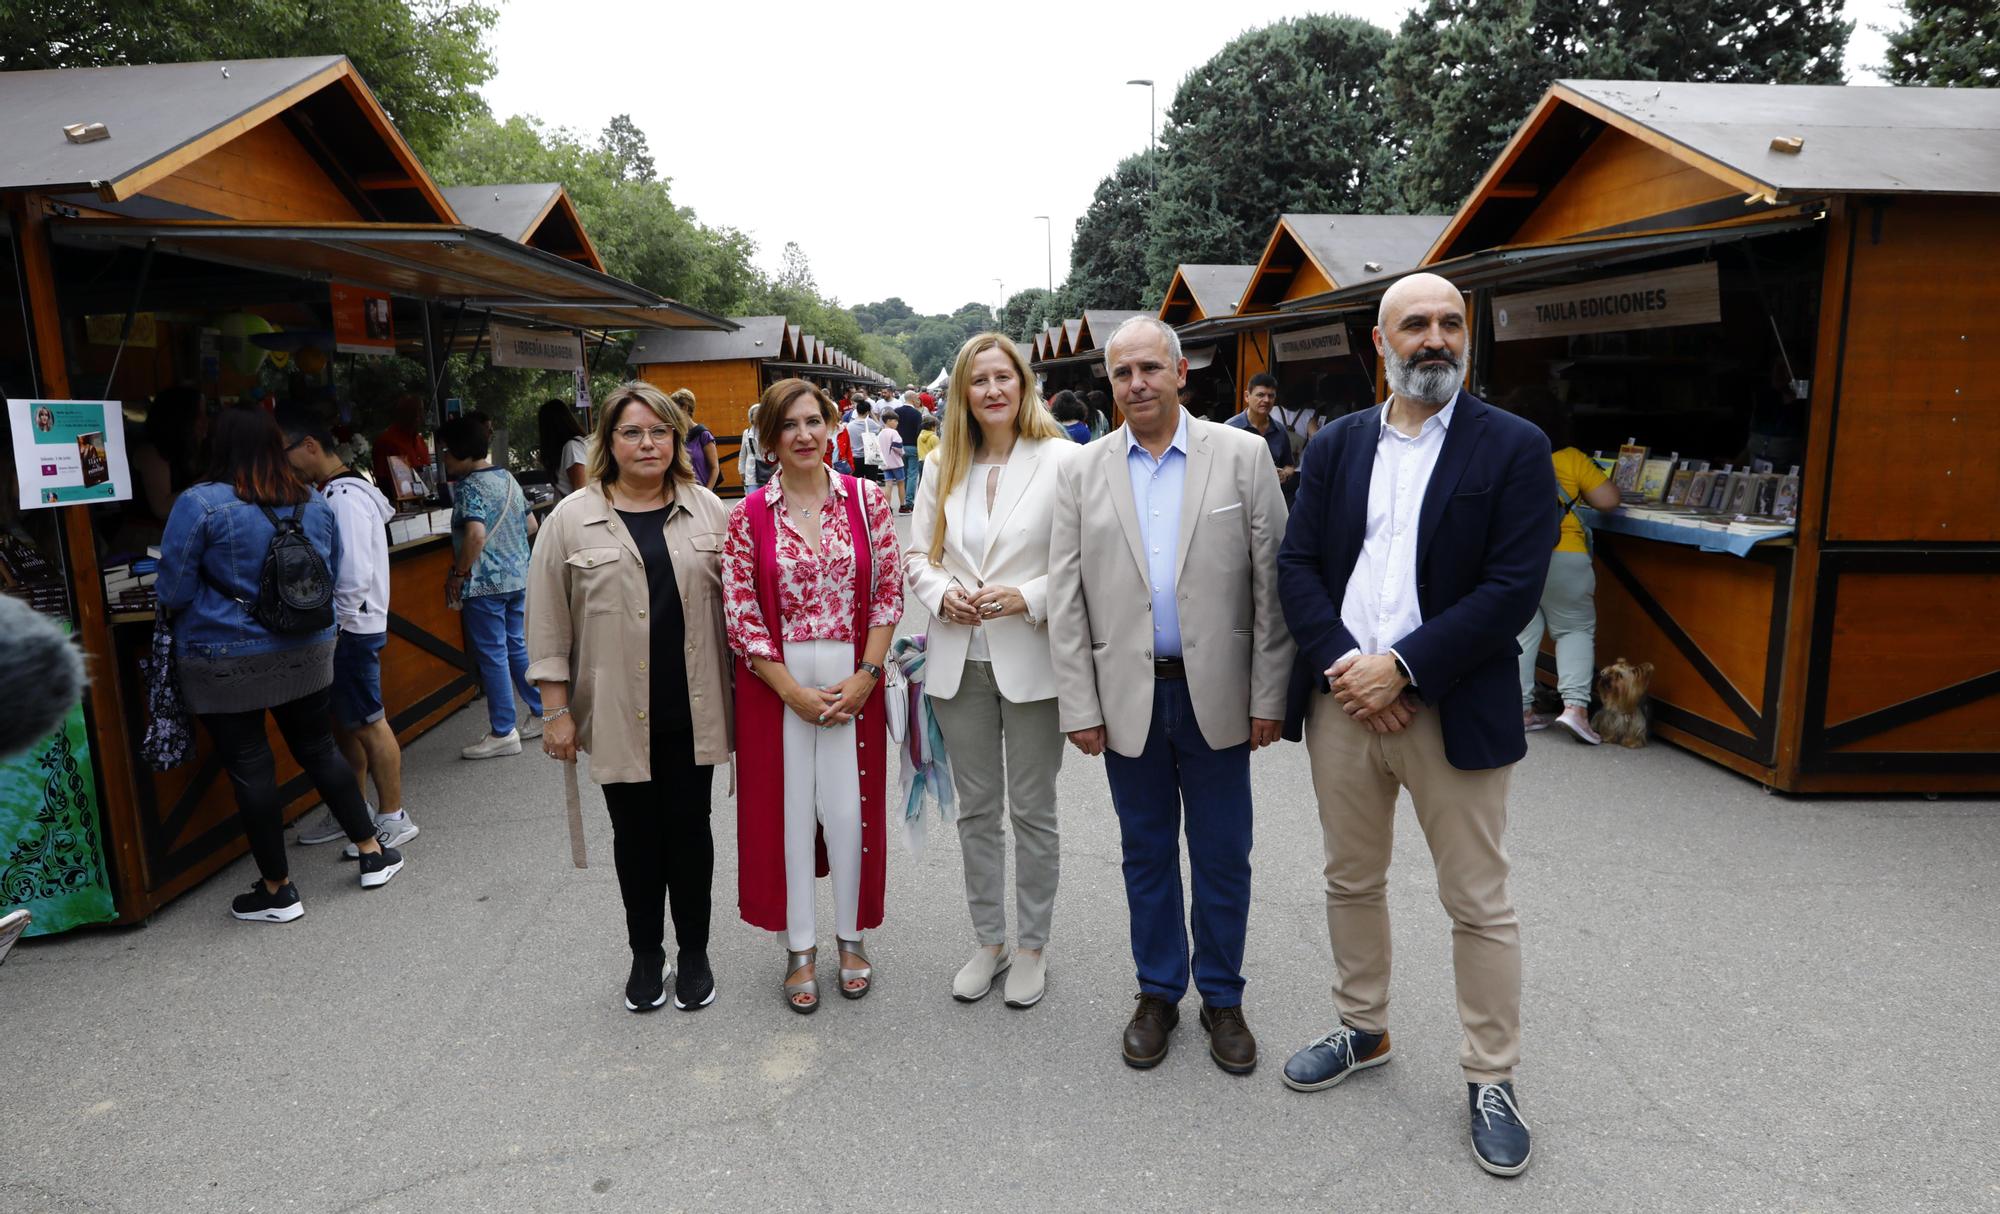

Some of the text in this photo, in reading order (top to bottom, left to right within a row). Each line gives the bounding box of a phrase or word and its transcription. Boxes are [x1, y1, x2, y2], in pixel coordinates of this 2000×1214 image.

[1535, 301, 1578, 323] TAULA
[1580, 288, 1667, 317] EDICIONES
[514, 338, 543, 356] LIBRERÍA
